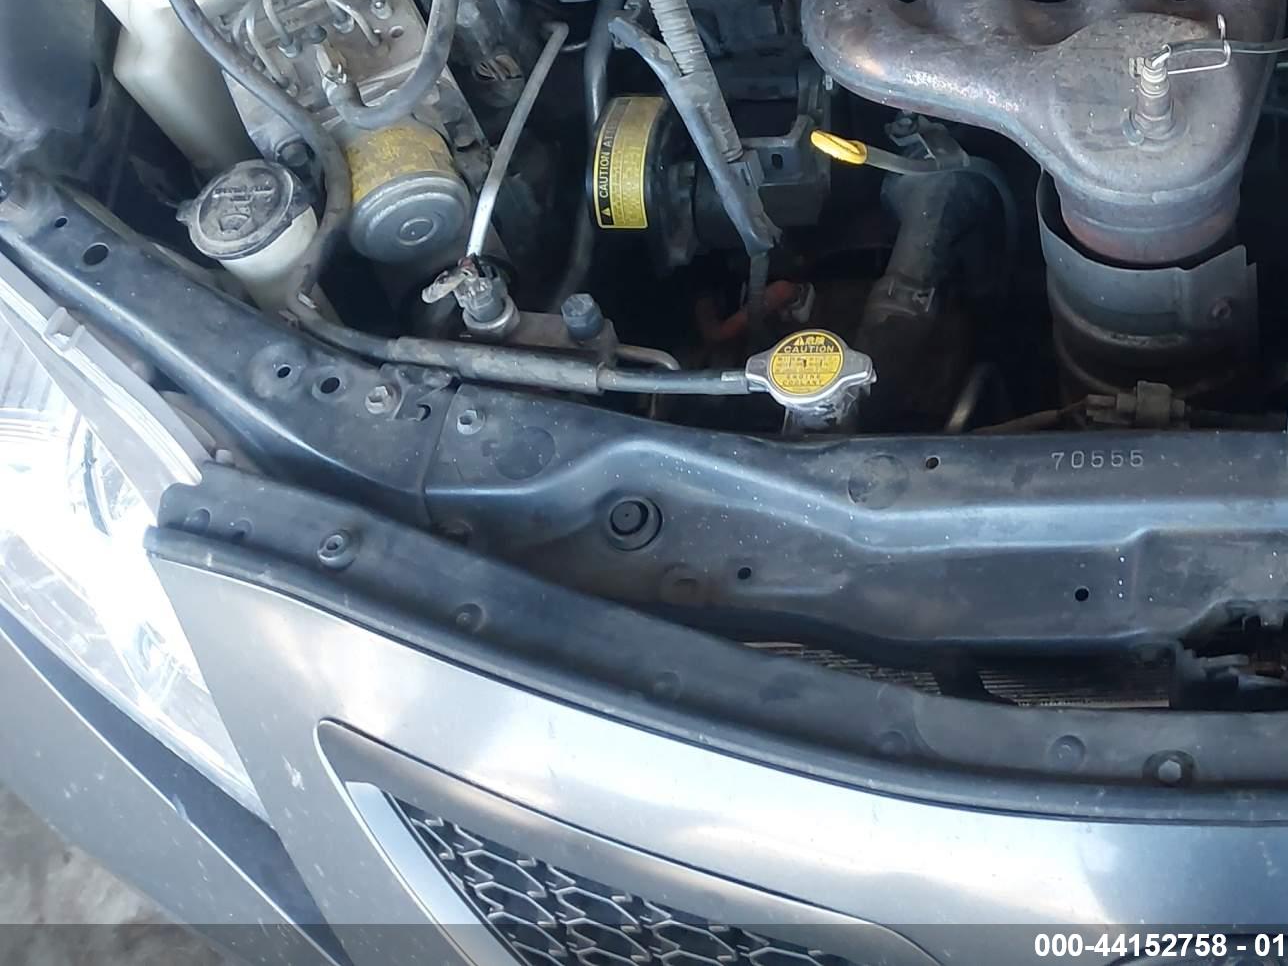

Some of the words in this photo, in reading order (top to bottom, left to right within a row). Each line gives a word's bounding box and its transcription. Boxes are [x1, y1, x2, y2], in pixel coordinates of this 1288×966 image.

[600, 152, 611, 199] CAUTION
[783, 345, 835, 353] CAUTION
[1050, 450, 1144, 471] 70555
